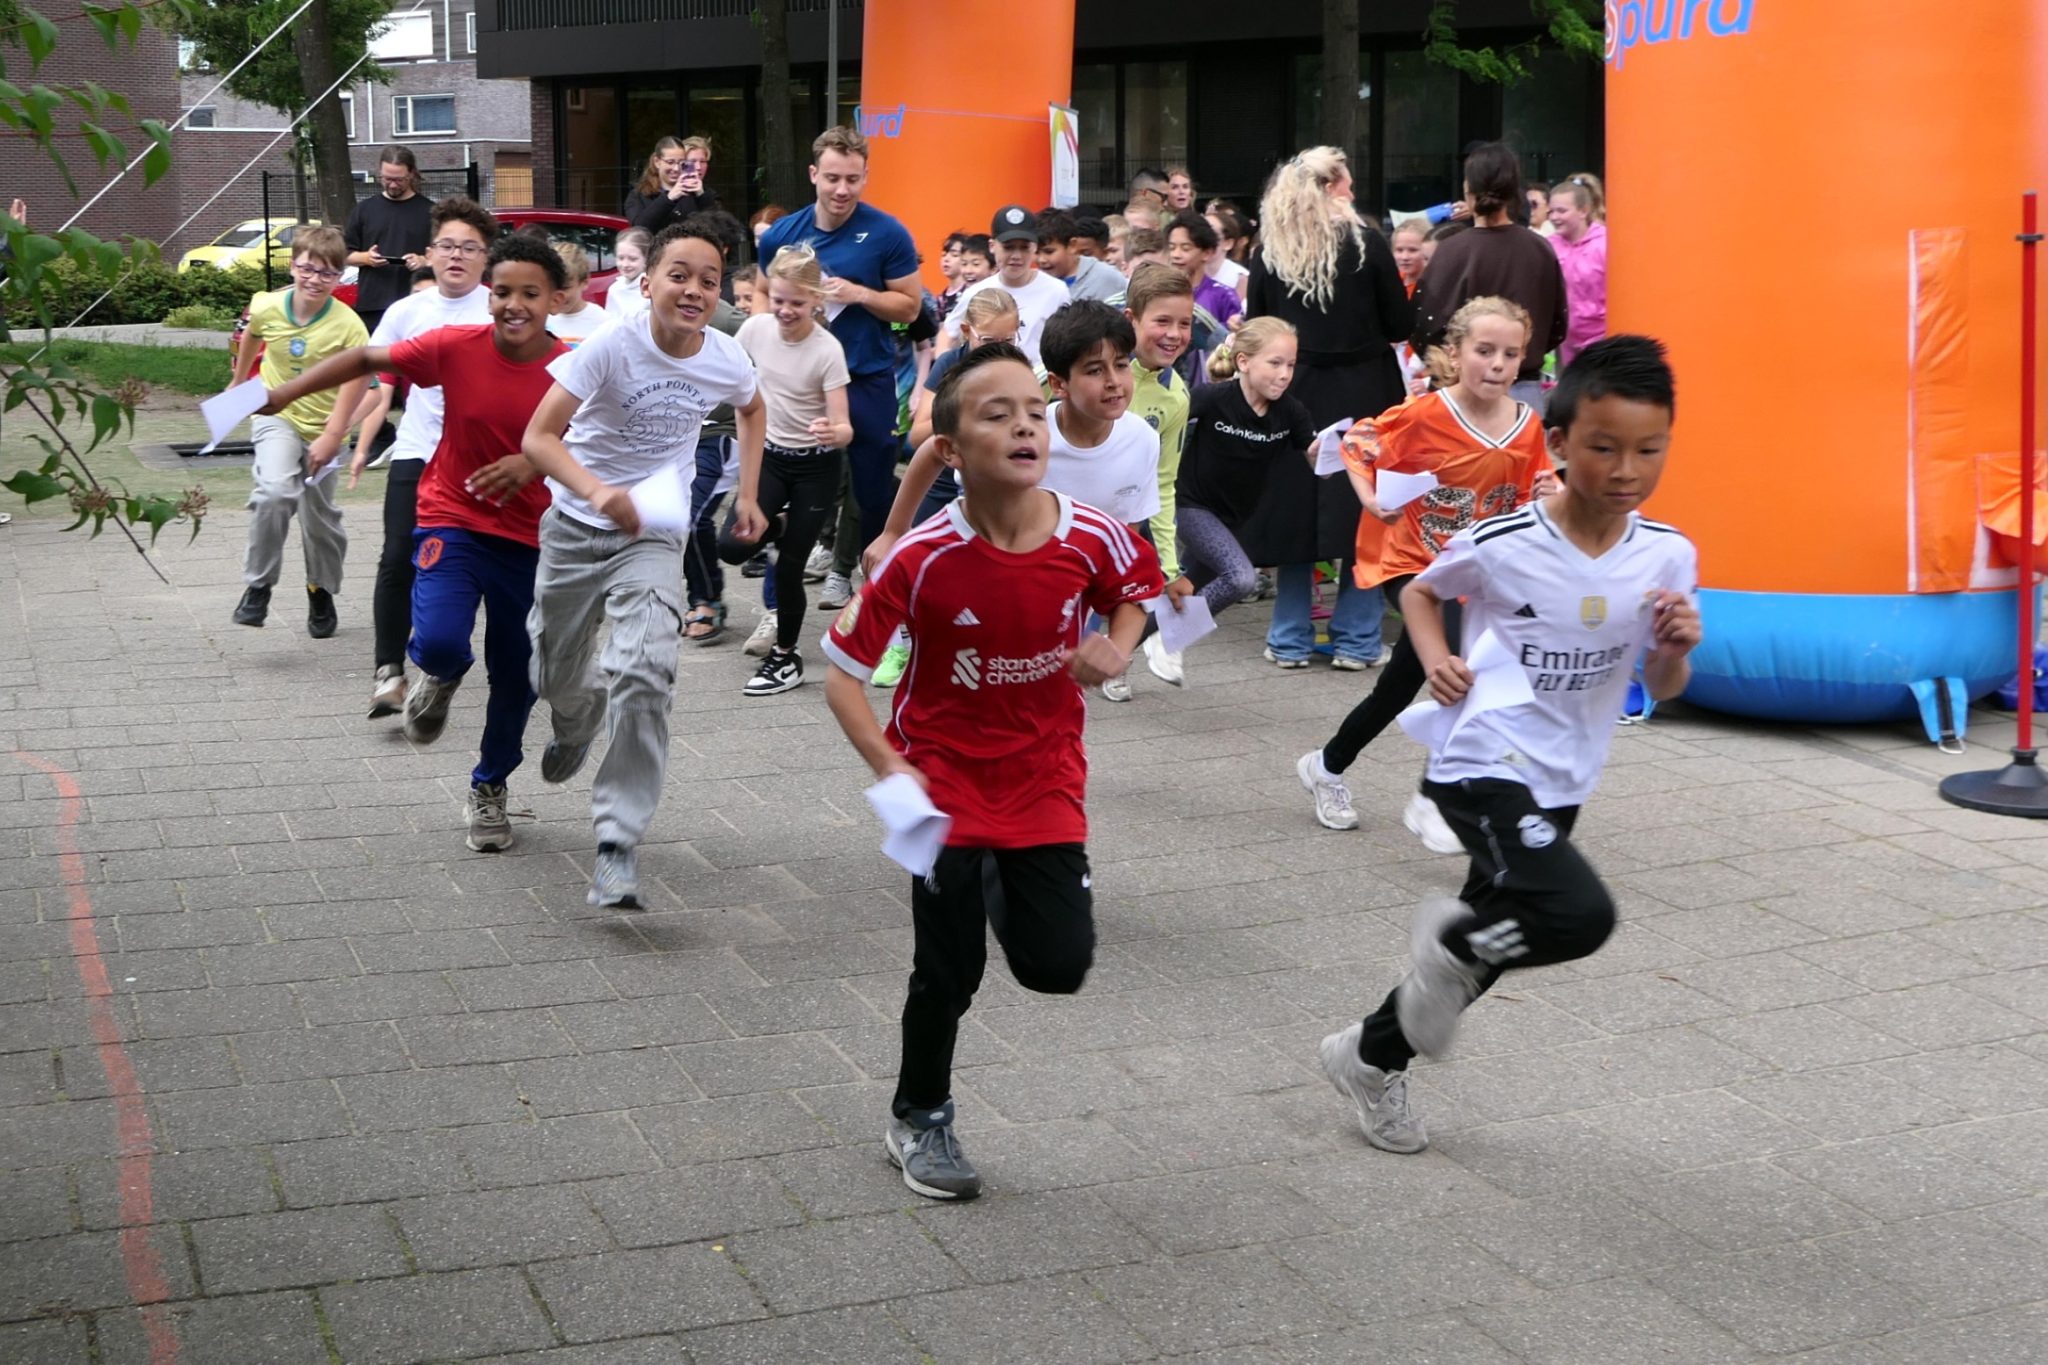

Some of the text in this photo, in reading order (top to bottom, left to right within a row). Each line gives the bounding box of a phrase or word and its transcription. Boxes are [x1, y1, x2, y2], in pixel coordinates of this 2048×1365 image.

[621, 382, 662, 411] NORTH
[665, 380, 700, 399] POINT
[1214, 421, 1245, 438] Calvin
[986, 641, 1066, 671] standard
